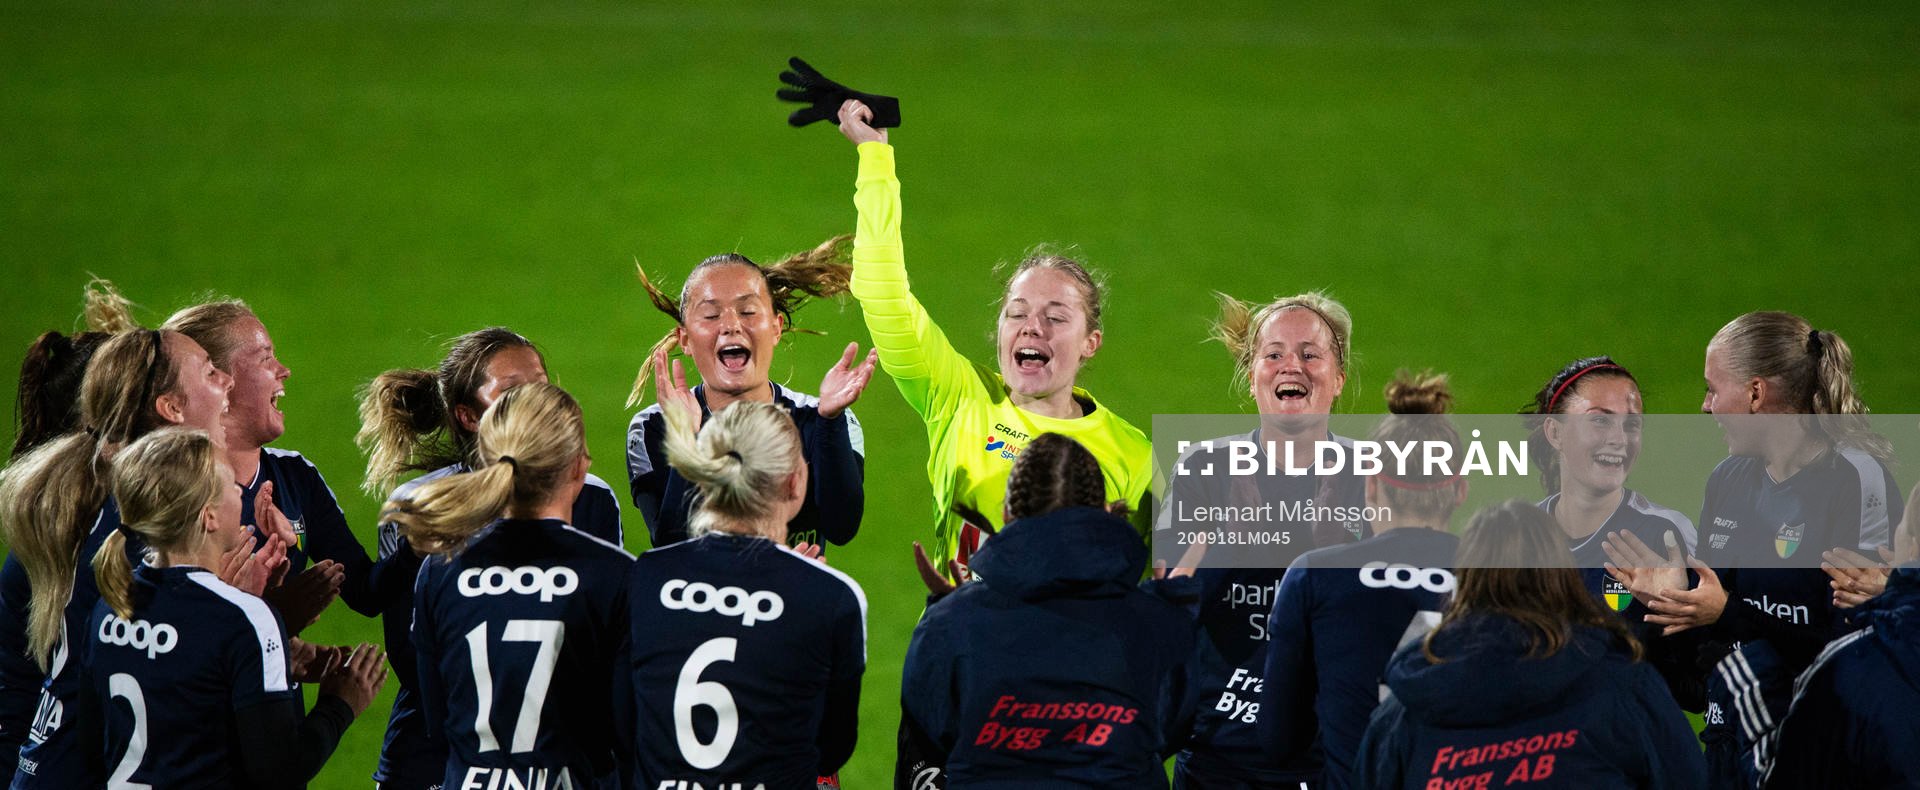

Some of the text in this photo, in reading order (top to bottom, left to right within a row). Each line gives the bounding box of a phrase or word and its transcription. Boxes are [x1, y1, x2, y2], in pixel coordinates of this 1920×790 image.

[994, 423, 1029, 441] CRAFT
[1004, 443, 1021, 455] INT
[1001, 450, 1015, 460] SP
[457, 566, 579, 602] coop
[660, 579, 784, 627] coop
[98, 613, 179, 660] coop
[465, 620, 565, 754] 17
[673, 637, 739, 770] 6
[988, 696, 1139, 725] Franssons
[107, 672, 152, 790] 2
[974, 723, 1114, 751] Bygg AB
[1431, 729, 1579, 775] Franssons
[1505, 754, 1556, 786] AB
